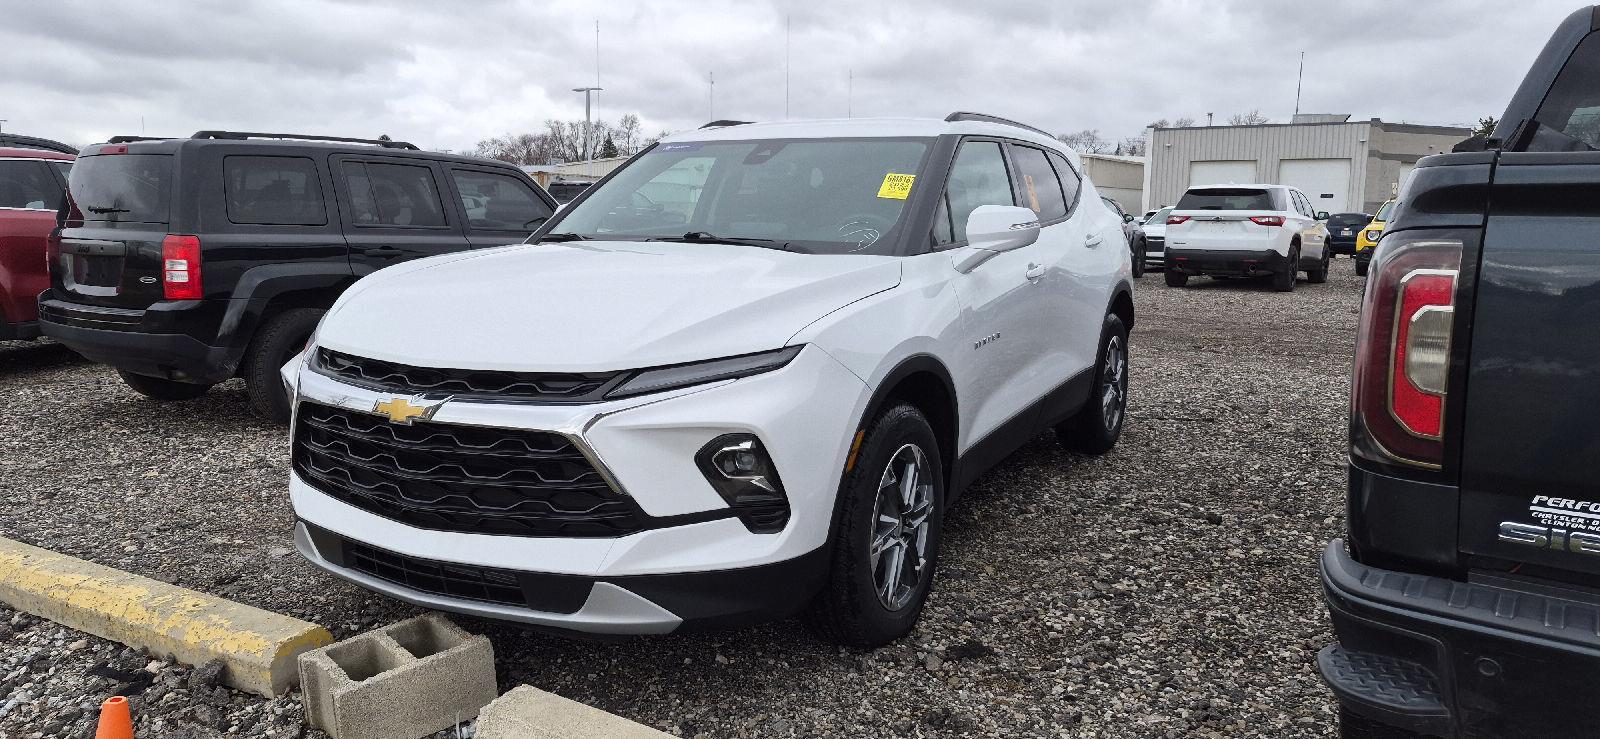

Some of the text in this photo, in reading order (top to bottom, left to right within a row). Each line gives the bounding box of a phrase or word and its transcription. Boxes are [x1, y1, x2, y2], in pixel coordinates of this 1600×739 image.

[1531, 494, 1600, 512] PERFO
[1531, 512, 1584, 523] CHRYSLER
[1541, 519, 1586, 530] CLINTON
